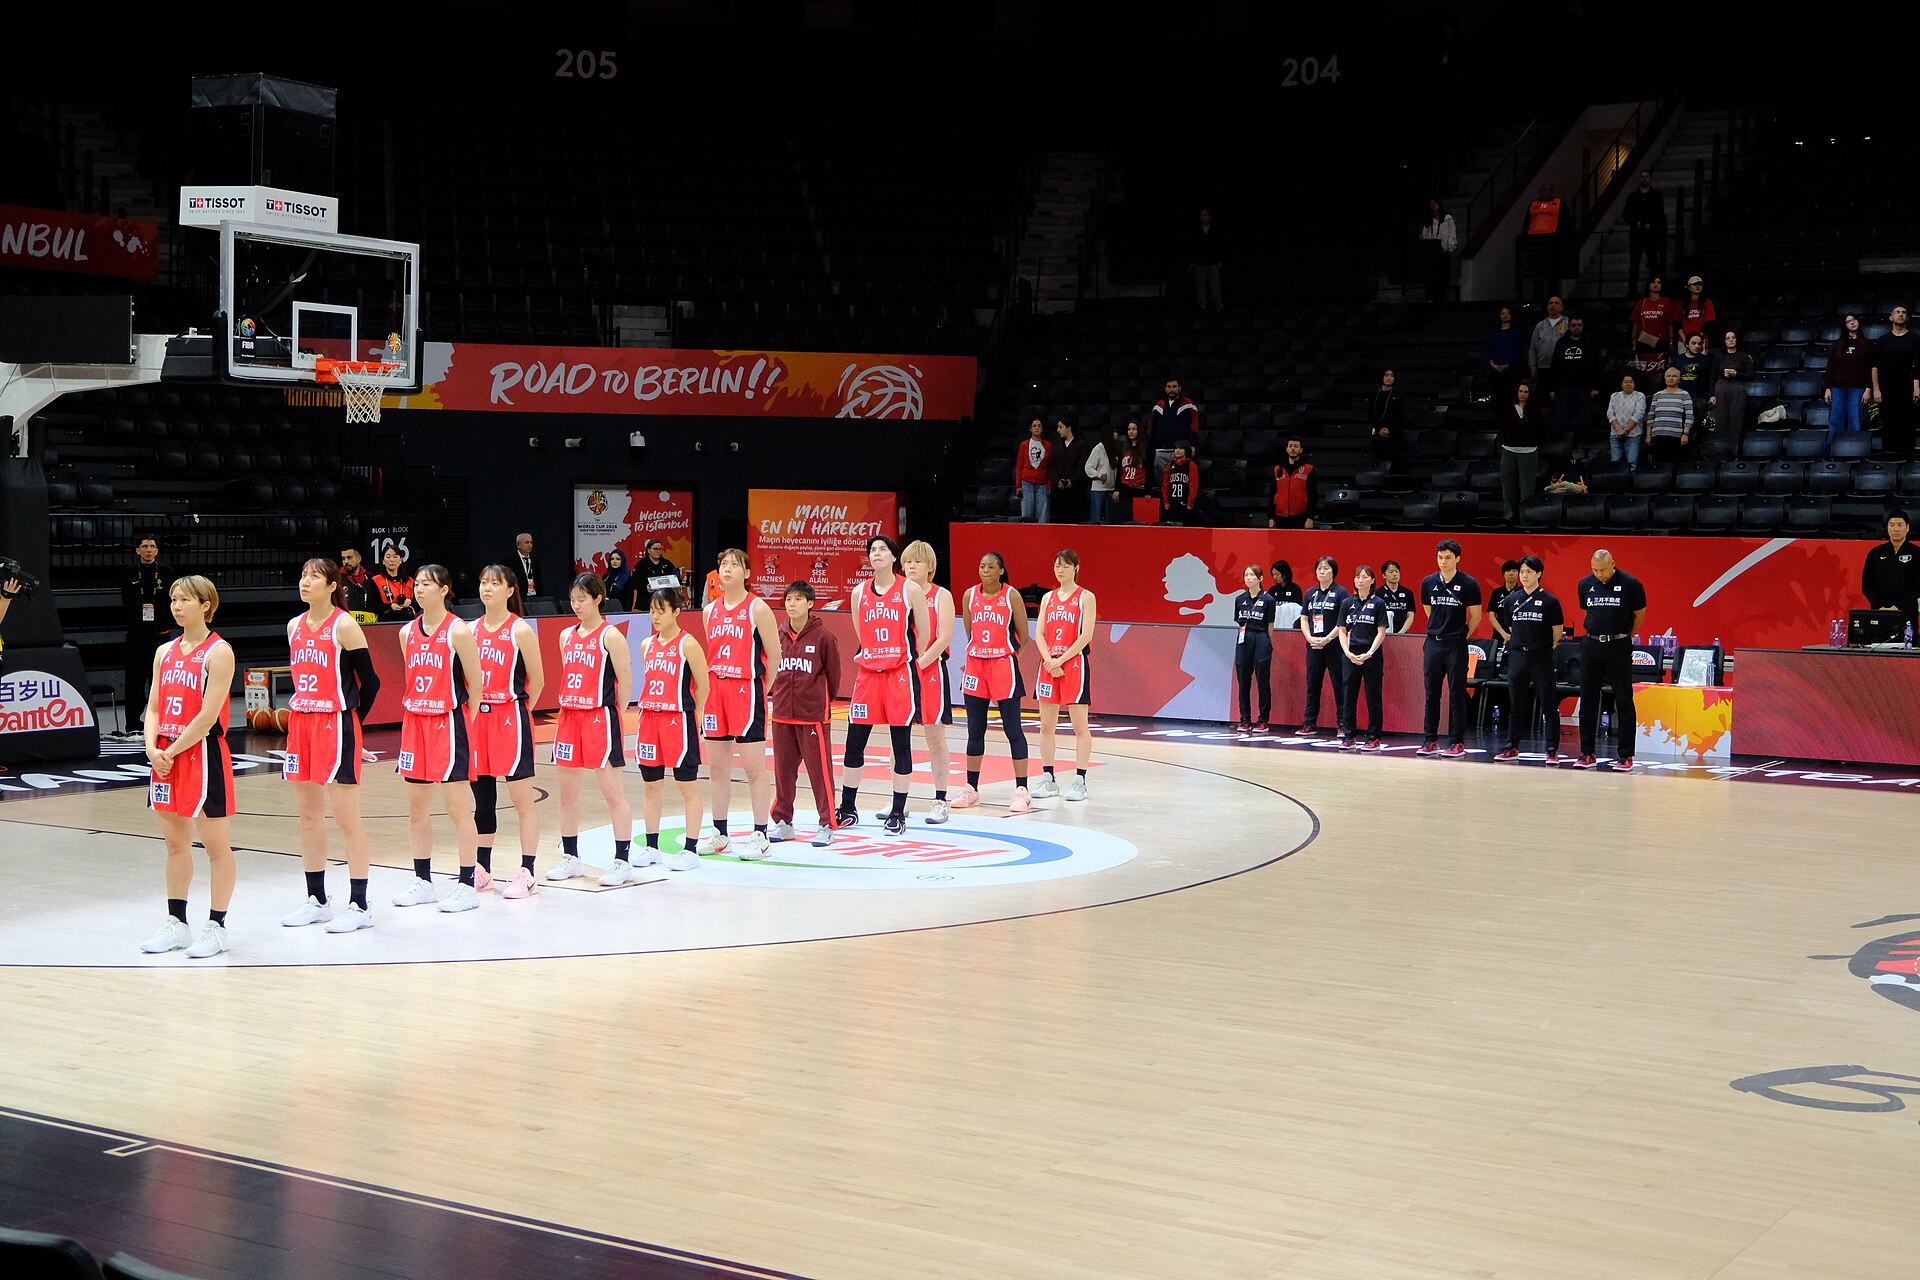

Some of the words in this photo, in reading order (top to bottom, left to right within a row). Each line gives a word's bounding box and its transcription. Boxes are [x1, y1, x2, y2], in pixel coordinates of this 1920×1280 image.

[555, 48, 618, 80] 205
[1280, 54, 1341, 87] 204
[205, 198, 245, 208] TISSOT
[284, 202, 327, 217] TISSOT
[489, 360, 597, 405] ROAD
[601, 370, 629, 393] TO
[633, 358, 782, 401] BERLIN!!
[1125, 467, 1136, 480] 28
[1172, 483, 1183, 498] 28
[639, 510, 683, 521] Welcome
[795, 504, 848, 521] MAÇIN
[760, 519, 782, 535] EN
[787, 518, 807, 535] İYİ
[811, 520, 882, 537] HAREKETİ
[759, 536, 781, 545] Maçın
[782, 536, 819, 546] heyecanını
[757, 574, 785, 583] HAZNESİ
[865, 608, 899, 623] JAPAN
[972, 611, 1004, 625] JAPAN
[1047, 611, 1075, 624] JAPAN
[710, 624, 743, 640] JAPAN
[875, 628, 888, 642] 10
[982, 630, 990, 643] 3
[1055, 628, 1062, 640] 2
[291, 649, 328, 668] JAPAN
[564, 650, 595, 668] JAPAN
[717, 645, 731, 659] 14
[408, 652, 442, 669] JAPAN
[645, 658, 676, 676] JAPAN
[778, 658, 812, 674] JAPAN
[298, 674, 319, 692] 52
[415, 676, 433, 693] 37
[567, 673, 583, 689] 26
[649, 680, 664, 696] 23
[0, 680, 61, 702] 百岁山
[165, 696, 183, 716] 75
